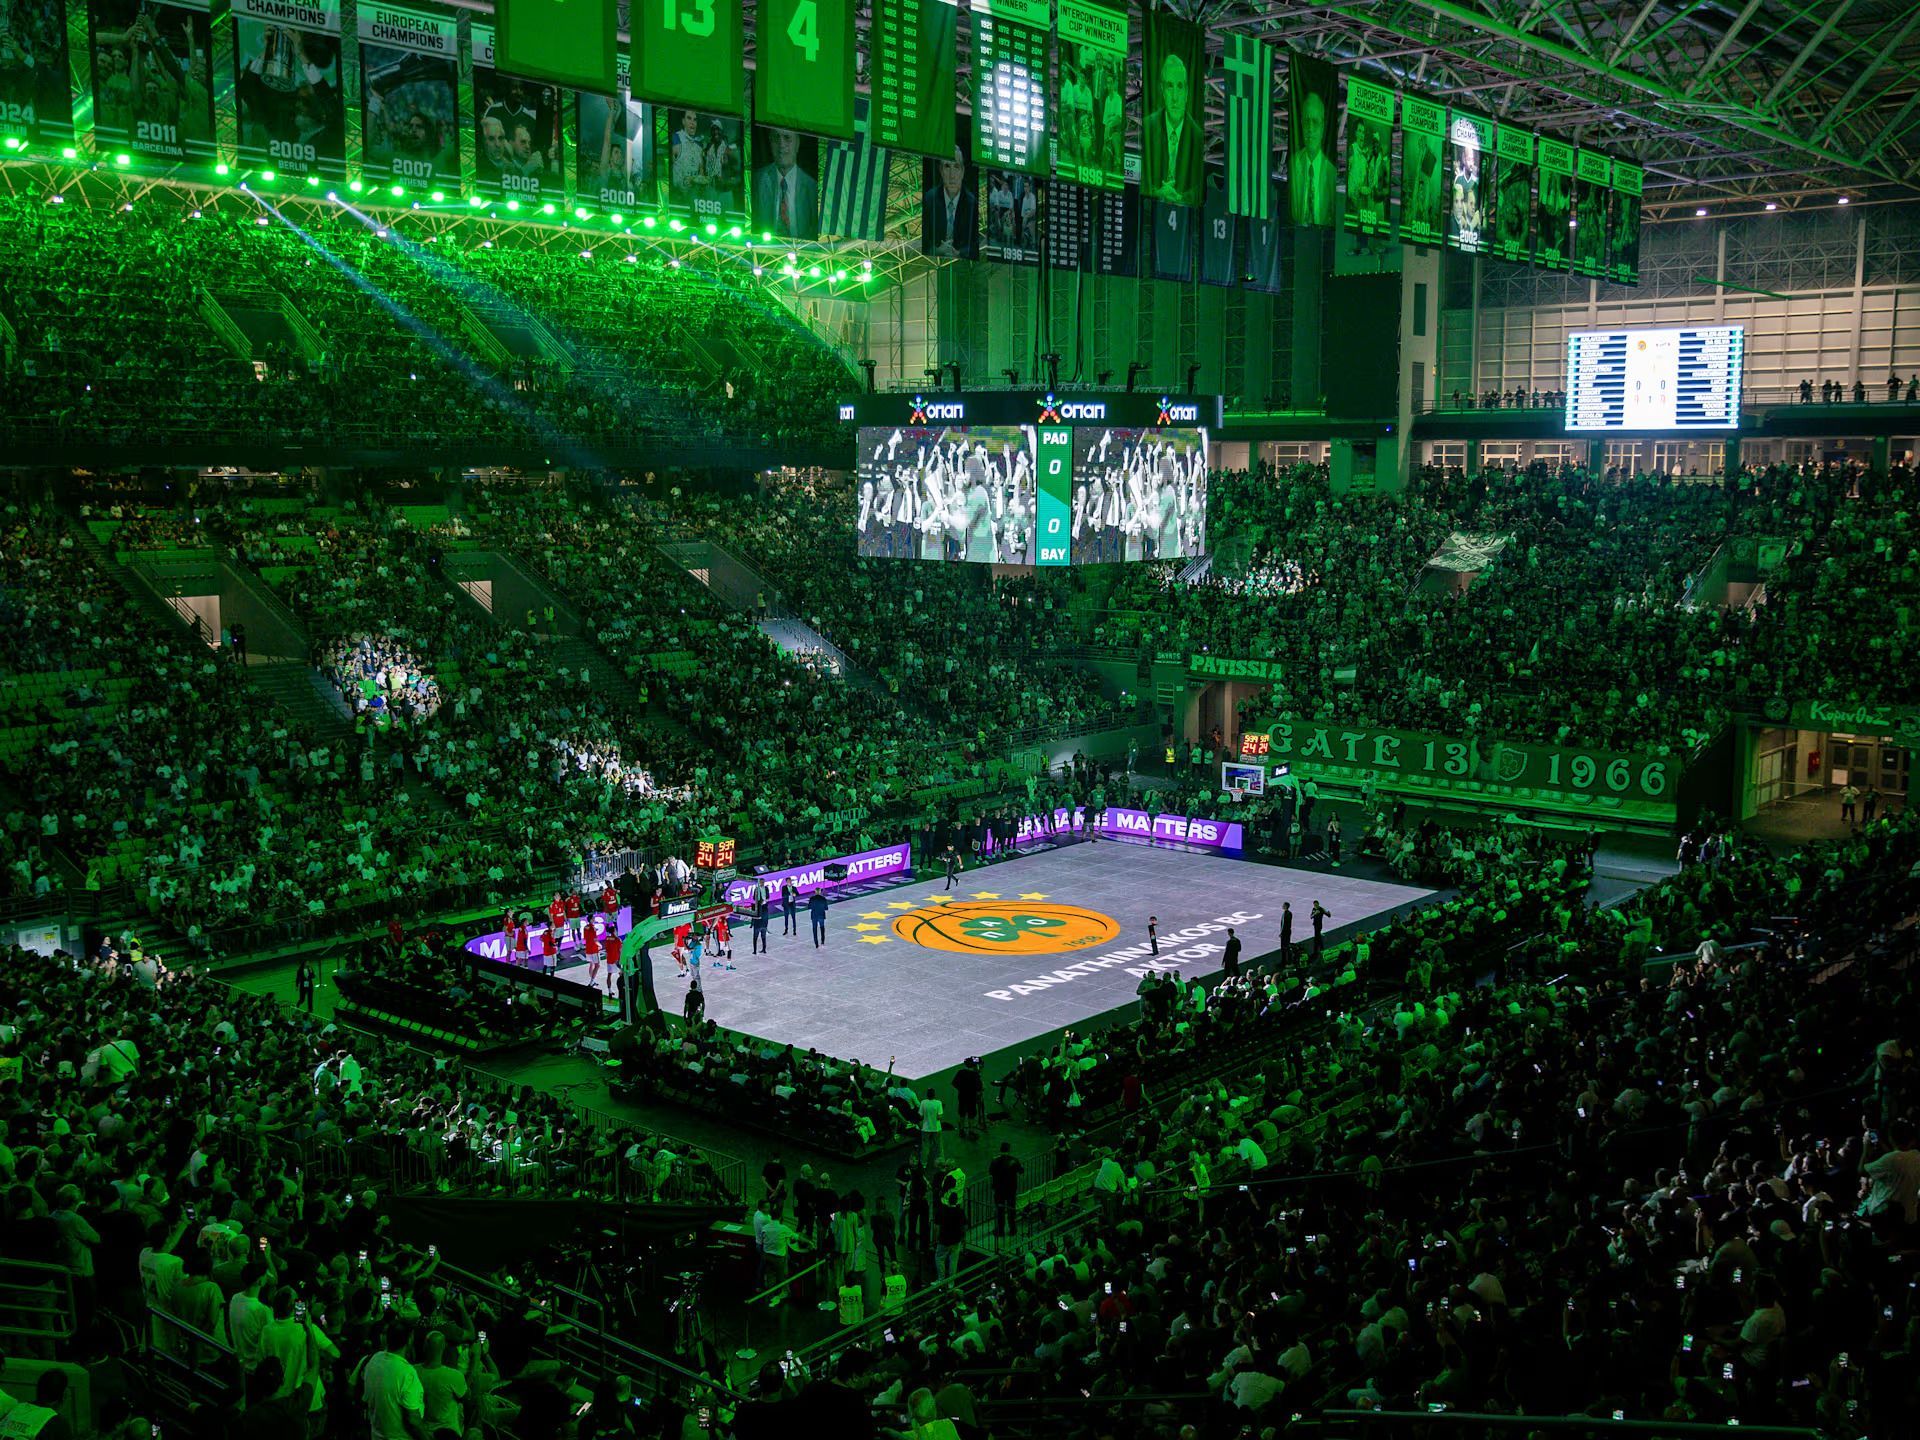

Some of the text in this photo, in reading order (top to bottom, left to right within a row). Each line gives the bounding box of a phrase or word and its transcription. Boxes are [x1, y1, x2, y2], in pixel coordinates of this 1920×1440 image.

[246, 0, 326, 25] CHAMPIONS
[664, 0, 715, 37] 13
[1060, 4, 1124, 34] INTERCONTINENTAL
[376, 11, 439, 35] EUROPEAN
[787, 0, 819, 62] 4
[1069, 21, 1116, 44] CUP WINNERS
[372, 24, 444, 49] CHAMPIONS
[1356, 86, 1386, 104] EUROPEAN
[1354, 97, 1388, 117] CHAMPIONS
[1411, 103, 1437, 121] EUROPEAN
[137, 121, 177, 143] 2011
[1408, 114, 1439, 132] CHAMPIONS
[132, 141, 183, 157] BARCELONA
[270, 140, 315, 162] 2009
[278, 160, 308, 172] BERLIN
[392, 158, 433, 178] 2007
[502, 174, 539, 193] 2002
[1078, 166, 1103, 187] 1996
[600, 187, 635, 206] 2000
[693, 199, 722, 215] 1996
[1168, 211, 1177, 231] 4
[1213, 219, 1226, 240] 13
[1412, 220, 1430, 236] 2000
[1459, 230, 1478, 245] 2002
[1043, 432, 1068, 445] PAO
[1049, 459, 1062, 475] 0
[1047, 518, 1060, 534] 0
[1041, 548, 1066, 560] BAY
[1190, 653, 1281, 679] PATISSIA
[1267, 723, 1666, 796] GATE 13 1966
[697, 852, 713, 867] 24
[716, 851, 733, 867] 24
[846, 851, 903, 876] ATTERS
[668, 901, 691, 914] bwin
[984, 910, 1264, 1001] PANATHINAIKOS BC
[1123, 942, 1227, 979] AKTOR
